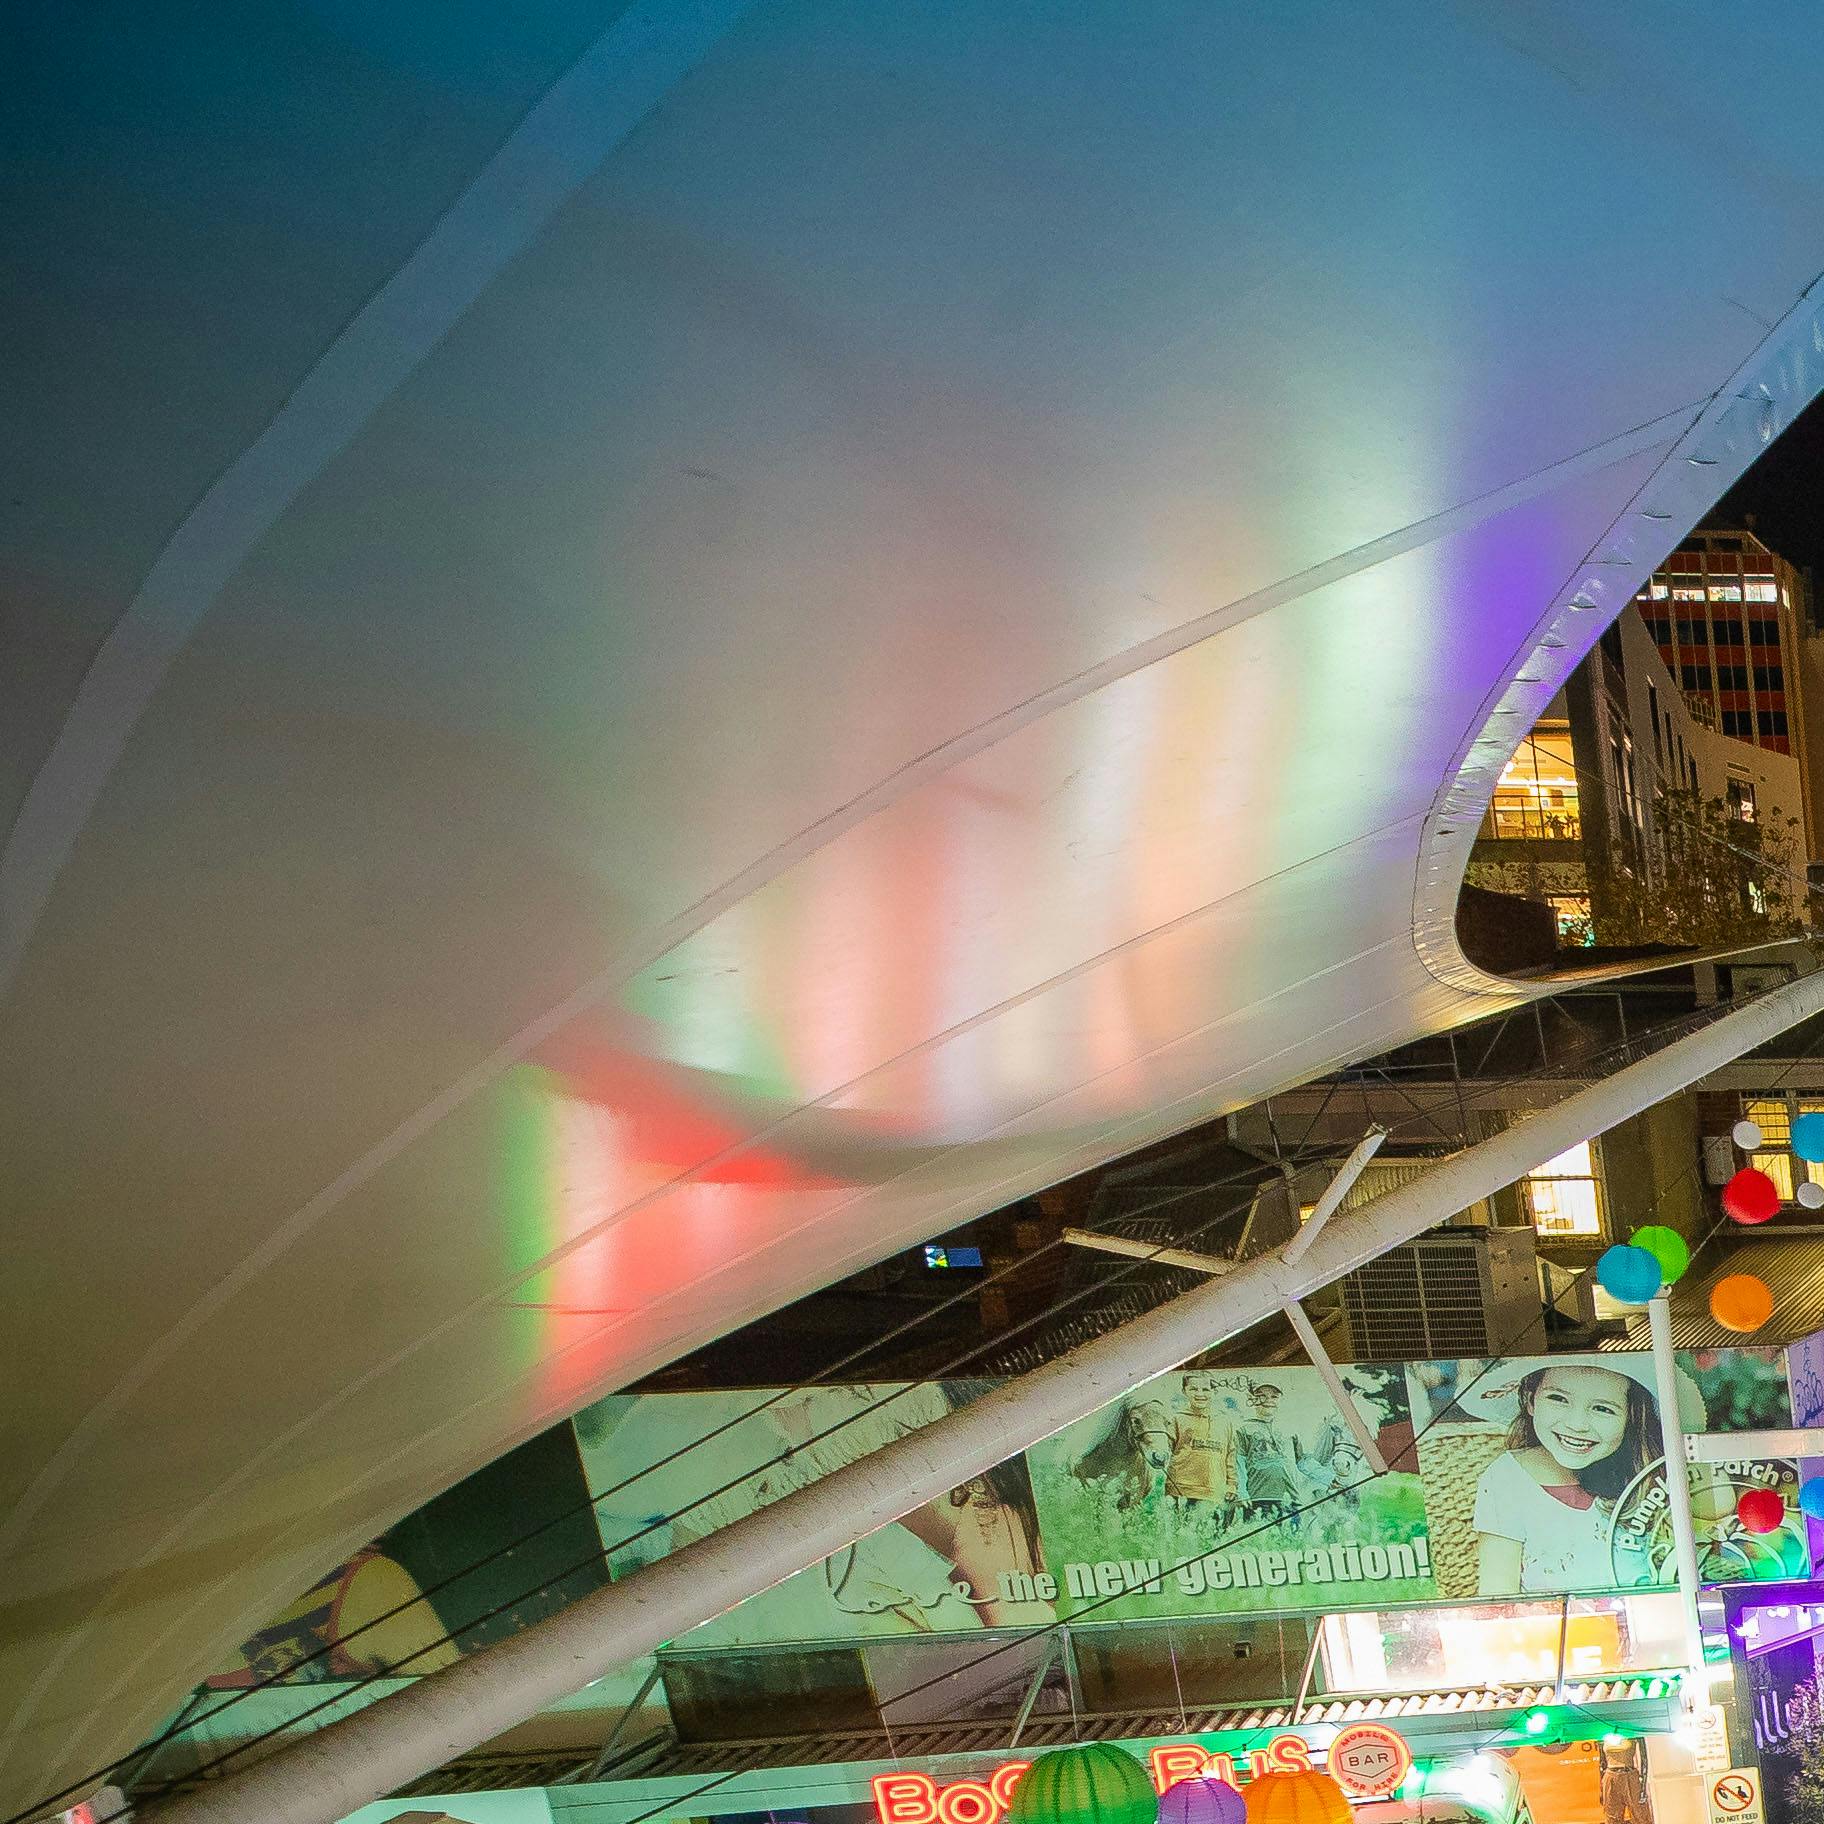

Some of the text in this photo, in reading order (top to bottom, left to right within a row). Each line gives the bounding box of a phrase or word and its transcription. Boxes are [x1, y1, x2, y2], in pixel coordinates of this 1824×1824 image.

[997, 1569, 1058, 1602] the
[1064, 1558, 1163, 1599] new
[1177, 1536, 1431, 1595] generation!
[1348, 1752, 1389, 1767] BAR
[1726, 1814, 1739, 1822] NOT
[1741, 1812, 1759, 1820] FEED
